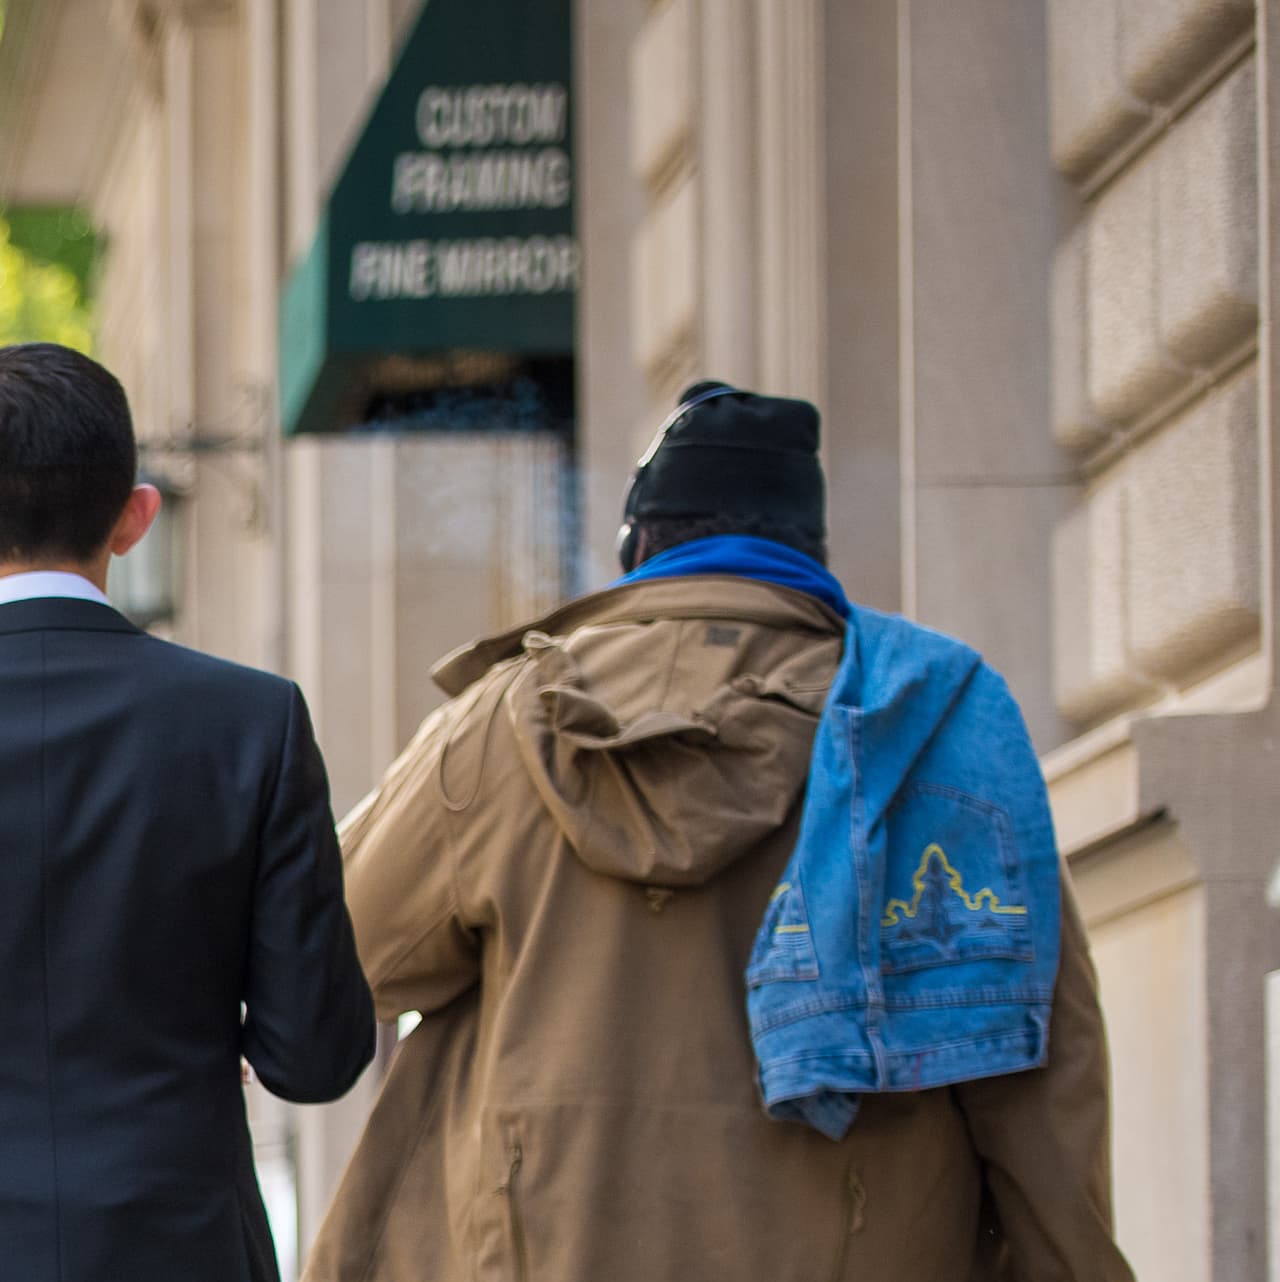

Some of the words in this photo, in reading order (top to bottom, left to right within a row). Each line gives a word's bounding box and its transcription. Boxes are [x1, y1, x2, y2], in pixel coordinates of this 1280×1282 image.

[417, 84, 568, 147] CUSTOM
[391, 148, 570, 214] FRAMING
[350, 239, 435, 301] FINE
